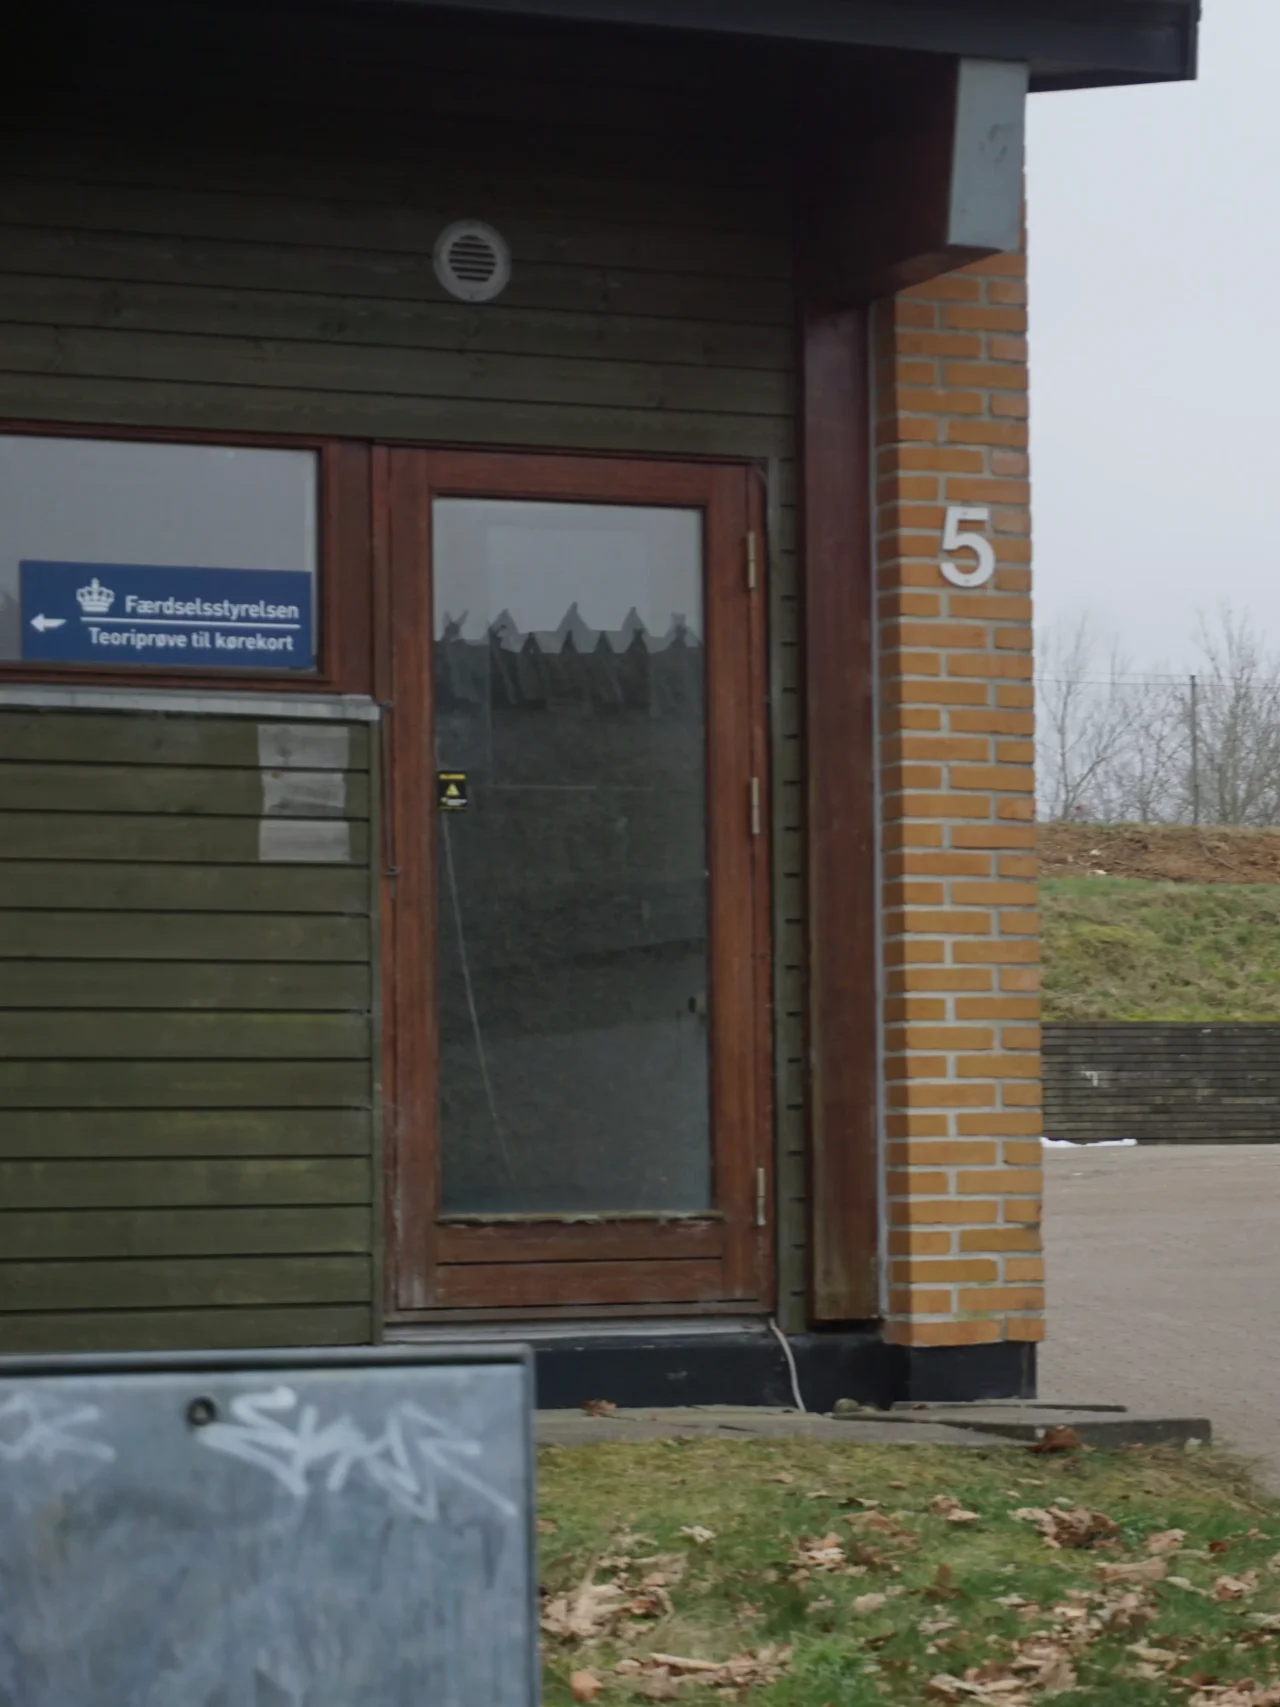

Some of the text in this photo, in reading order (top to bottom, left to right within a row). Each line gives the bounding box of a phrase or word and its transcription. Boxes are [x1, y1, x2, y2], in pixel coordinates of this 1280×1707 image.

[940, 506, 995, 588] 5
[125, 595, 299, 620] Færdselsstyrelsen
[88, 627, 294, 651] Teoriprøve til kørekort
